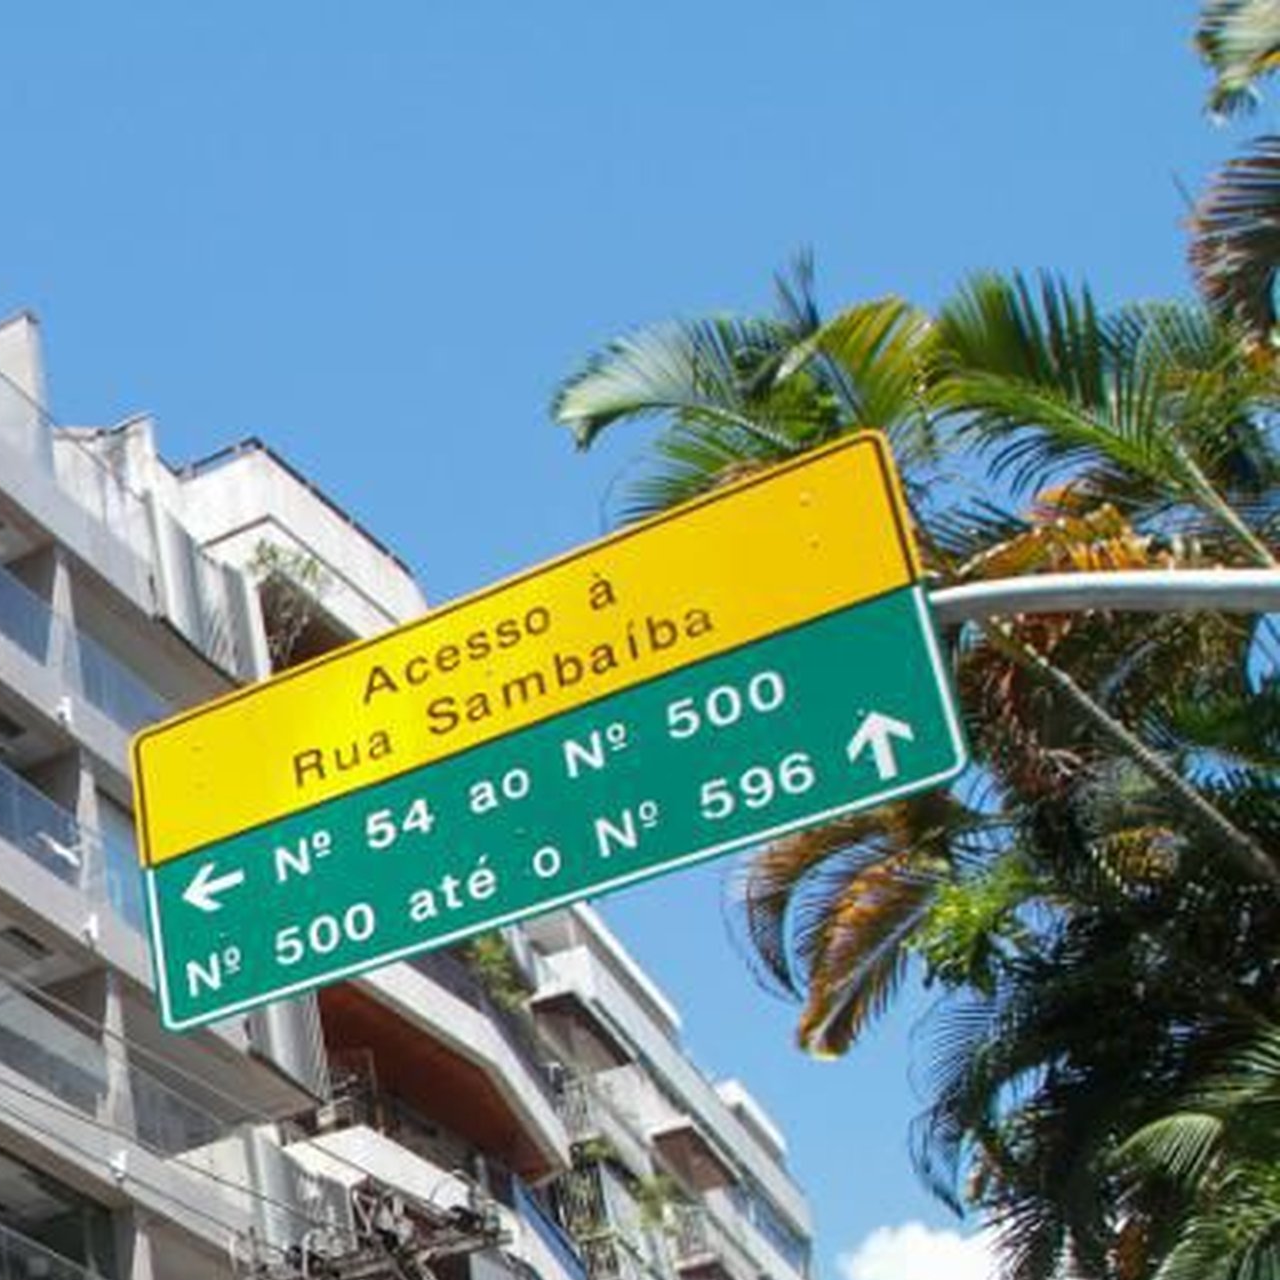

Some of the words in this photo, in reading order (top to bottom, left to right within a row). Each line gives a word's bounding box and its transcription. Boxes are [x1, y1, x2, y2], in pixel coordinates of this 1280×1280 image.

[292, 731, 394, 788] Rua
[426, 608, 715, 737] Sambaíba
[362, 605, 551, 705] Acesso
[588, 572, 617, 611] à
[365, 797, 435, 850] 54
[468, 767, 531, 814] ao
[666, 670, 786, 739] 500
[274, 902, 376, 966] 500
[408, 853, 498, 923] até
[532, 845, 562, 879] o
[700, 751, 816, 820] 596
